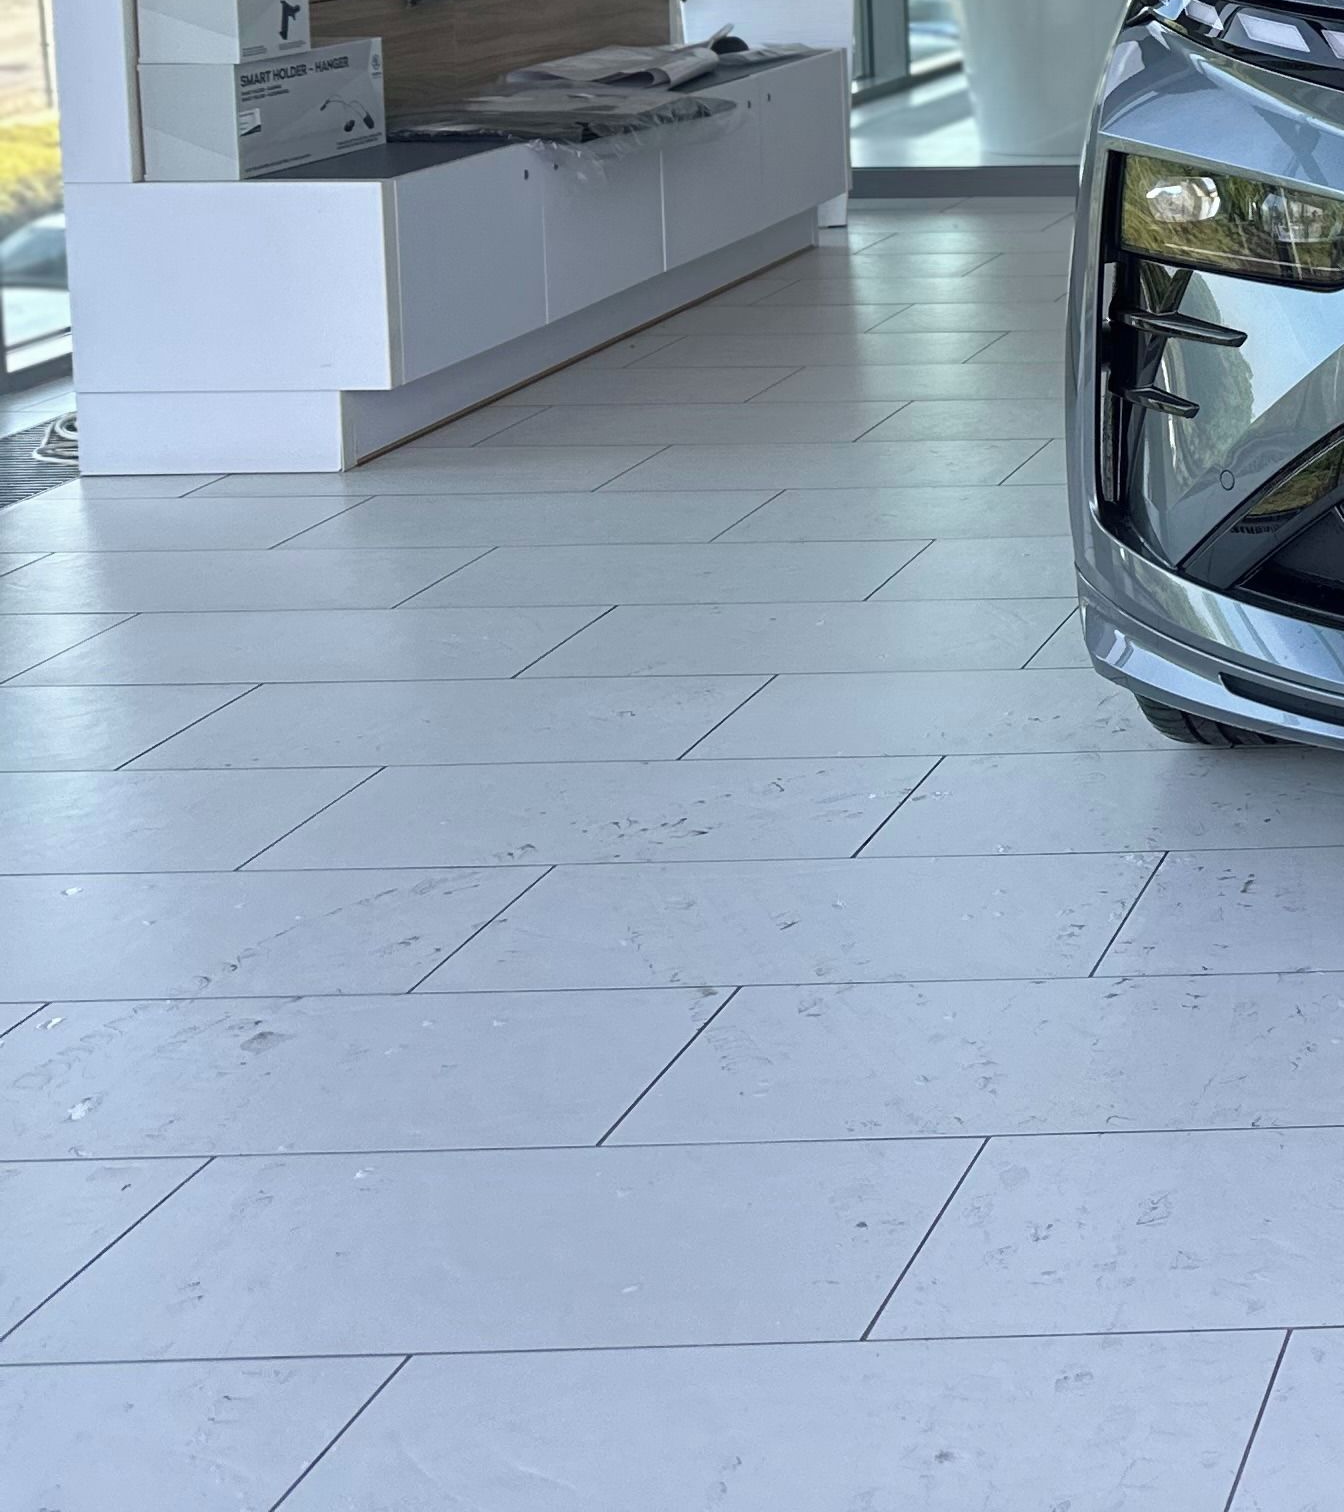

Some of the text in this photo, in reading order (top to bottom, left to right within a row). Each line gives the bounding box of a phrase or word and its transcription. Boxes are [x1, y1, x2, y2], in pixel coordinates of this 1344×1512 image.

[240, 70, 271, 88] SMART
[273, 64, 307, 81] HOLDER
[315, 56, 350, 73] HANGER
